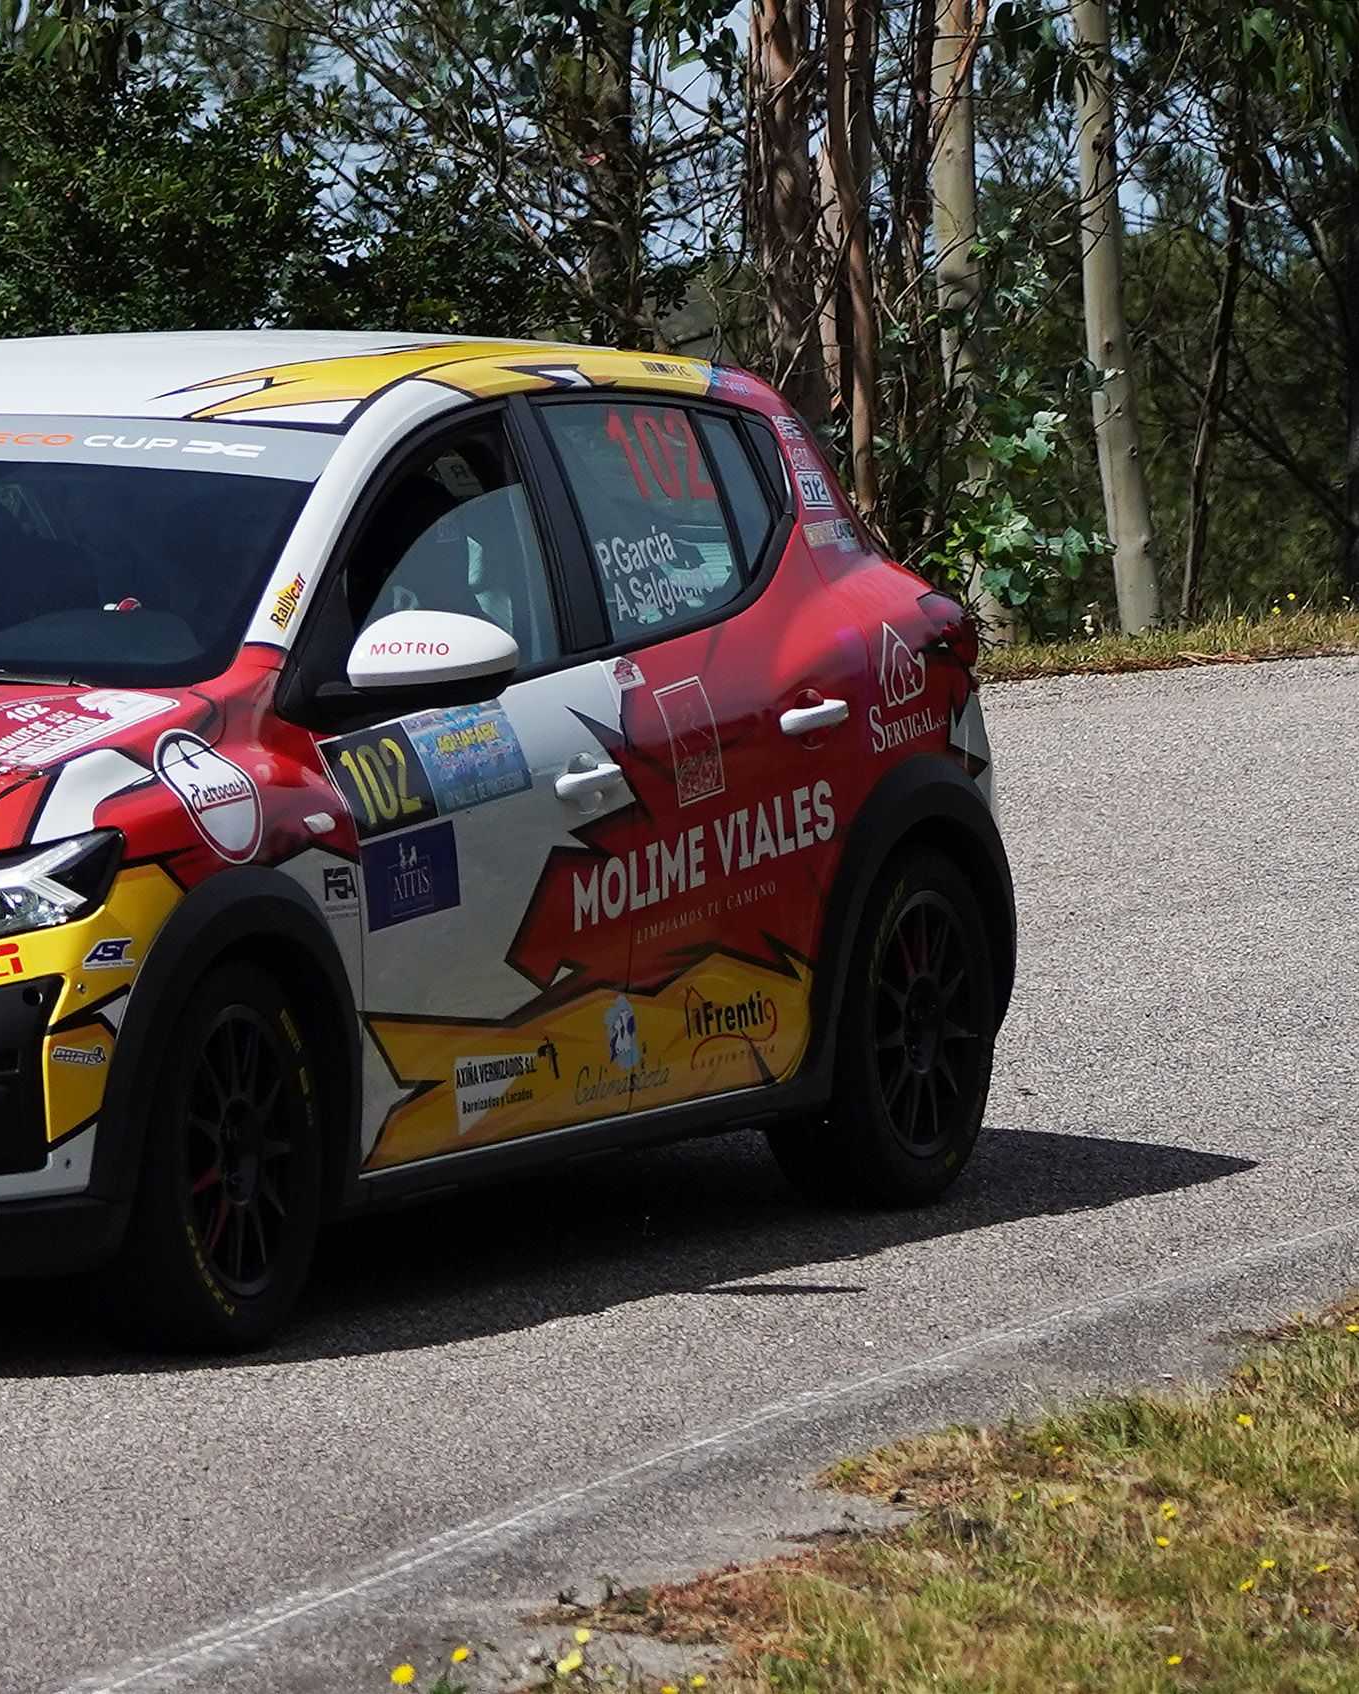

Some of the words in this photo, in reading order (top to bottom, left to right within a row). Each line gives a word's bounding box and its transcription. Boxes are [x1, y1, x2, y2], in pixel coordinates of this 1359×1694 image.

[83, 433, 178, 450] CUP
[606, 408, 716, 500] 102
[270, 571, 306, 627] Rallycar
[370, 641, 450, 657] MOTRIO
[6, 702, 51, 723] 102
[869, 703, 934, 754] SERVIGAL
[188, 771, 250, 812] Petrocash
[341, 736, 423, 825] 102
[572, 823, 707, 932] MOLIME
[714, 779, 837, 877] VIALES
[393, 866, 431, 901] ATTIS
[635, 906, 703, 945] LIMPIAMOS
[707, 901, 721, 918] TU
[726, 879, 776, 911] CAMINO
